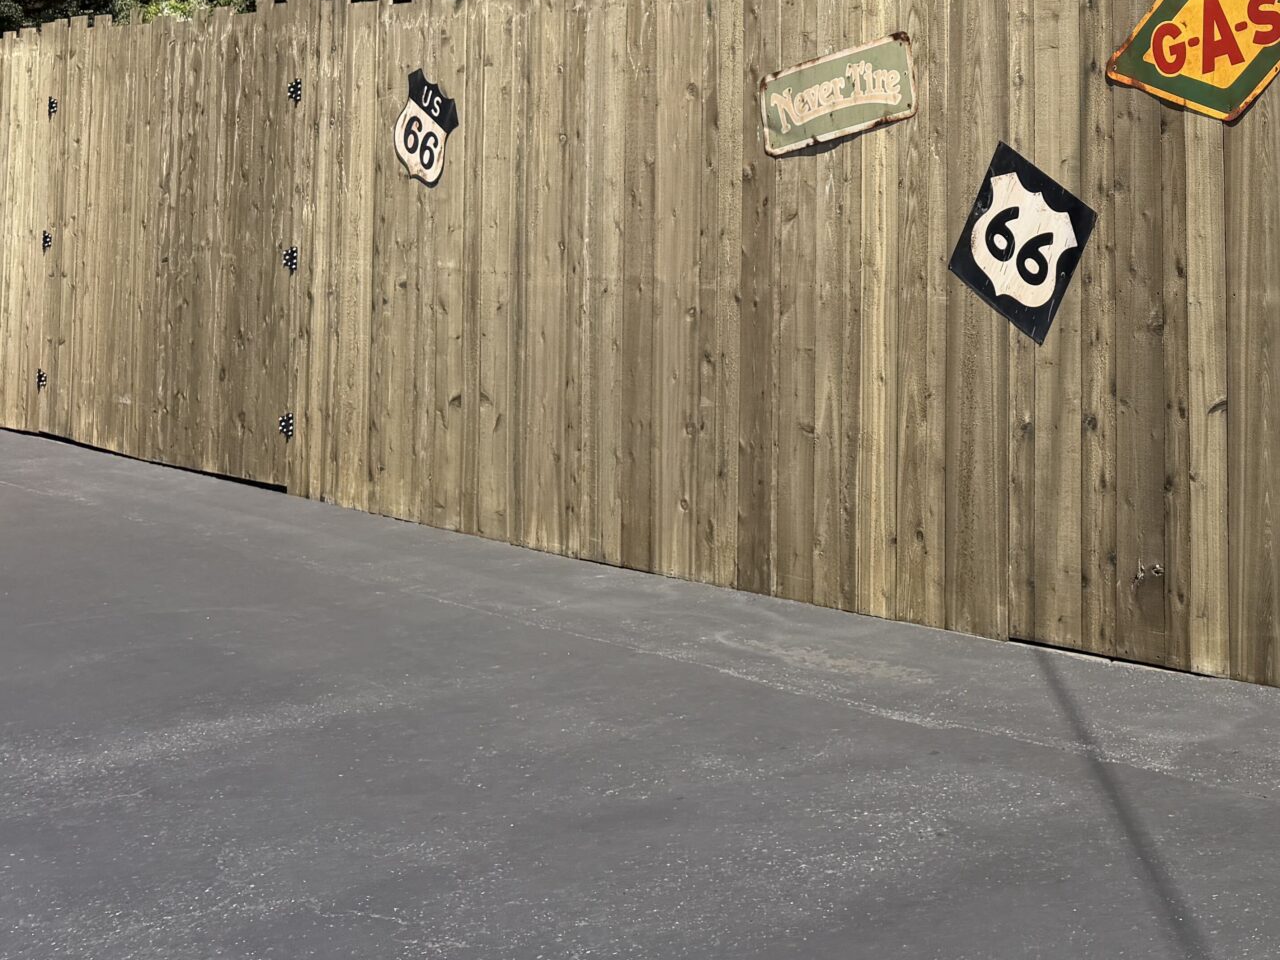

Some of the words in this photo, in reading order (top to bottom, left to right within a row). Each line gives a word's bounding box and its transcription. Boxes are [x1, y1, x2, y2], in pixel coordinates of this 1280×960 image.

[421, 85, 443, 117] US
[770, 76, 846, 135] Never
[845, 59, 902, 98] Tire
[403, 115, 439, 170] 66
[985, 206, 1054, 286] 66
